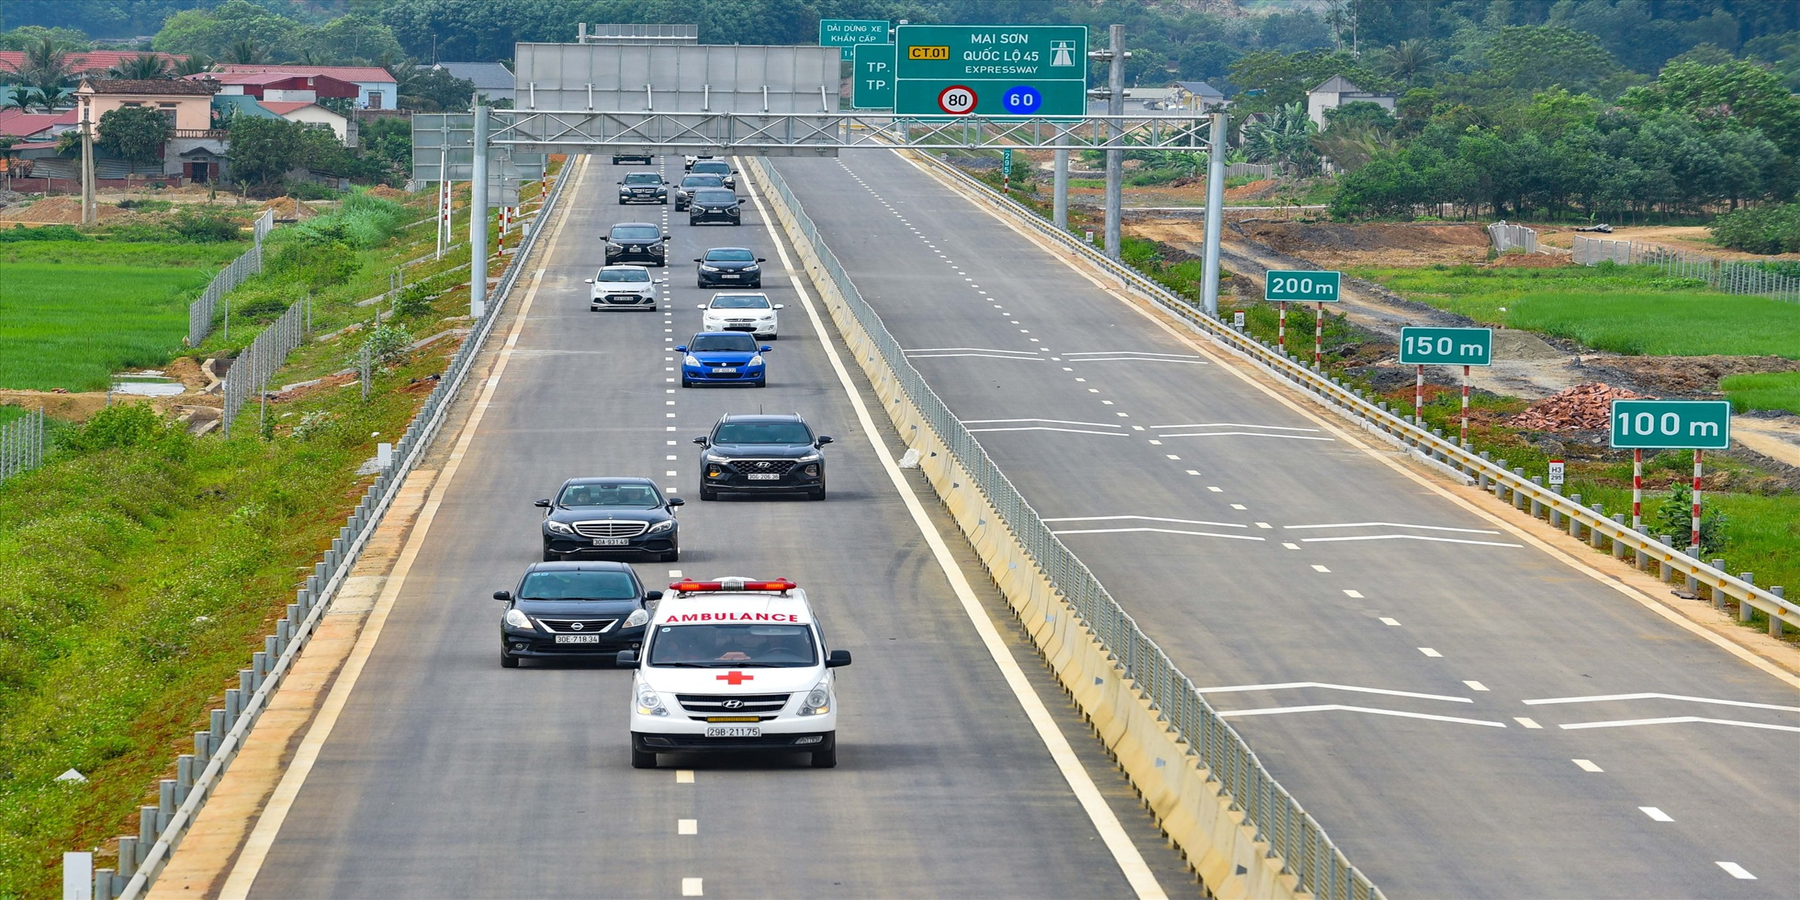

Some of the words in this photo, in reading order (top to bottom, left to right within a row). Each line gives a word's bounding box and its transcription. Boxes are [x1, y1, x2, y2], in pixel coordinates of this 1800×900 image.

[858, 33, 877, 42] CẤP
[971, 33, 996, 44] MAI
[1000, 33, 1029, 44] SƠN
[912, 48, 946, 58] CT.01
[963, 47, 1000, 62] QUỐC
[1004, 49, 1021, 63] LỘ
[1023, 51, 1039, 61] 45
[866, 62, 890, 73] TP.
[965, 66, 1039, 74] EXPRESSWAY
[866, 80, 890, 90] TP.
[948, 94, 968, 106] 80
[666, 612, 798, 623] AMBULANCE
